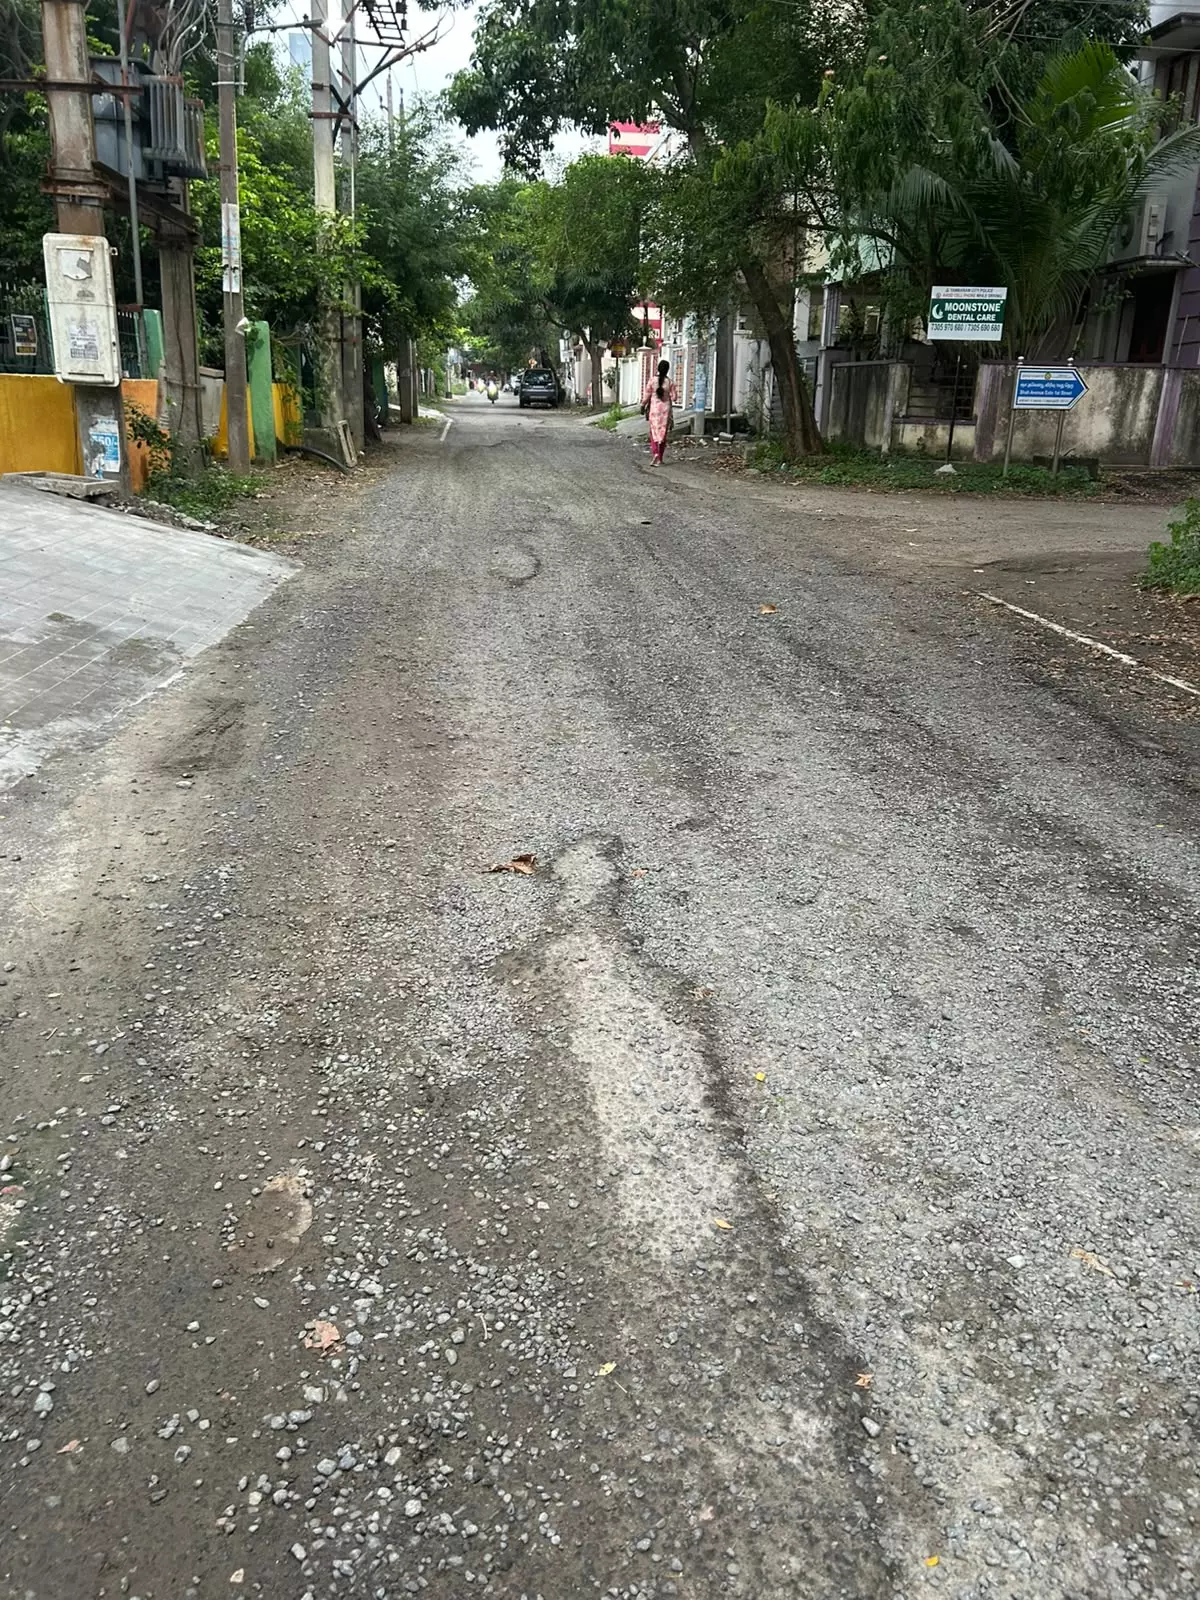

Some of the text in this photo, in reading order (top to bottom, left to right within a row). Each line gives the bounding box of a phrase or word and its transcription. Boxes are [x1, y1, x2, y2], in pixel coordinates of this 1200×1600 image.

[944, 302, 1001, 312] MOONSTONE
[947, 313, 996, 322] DENTAL CARE
